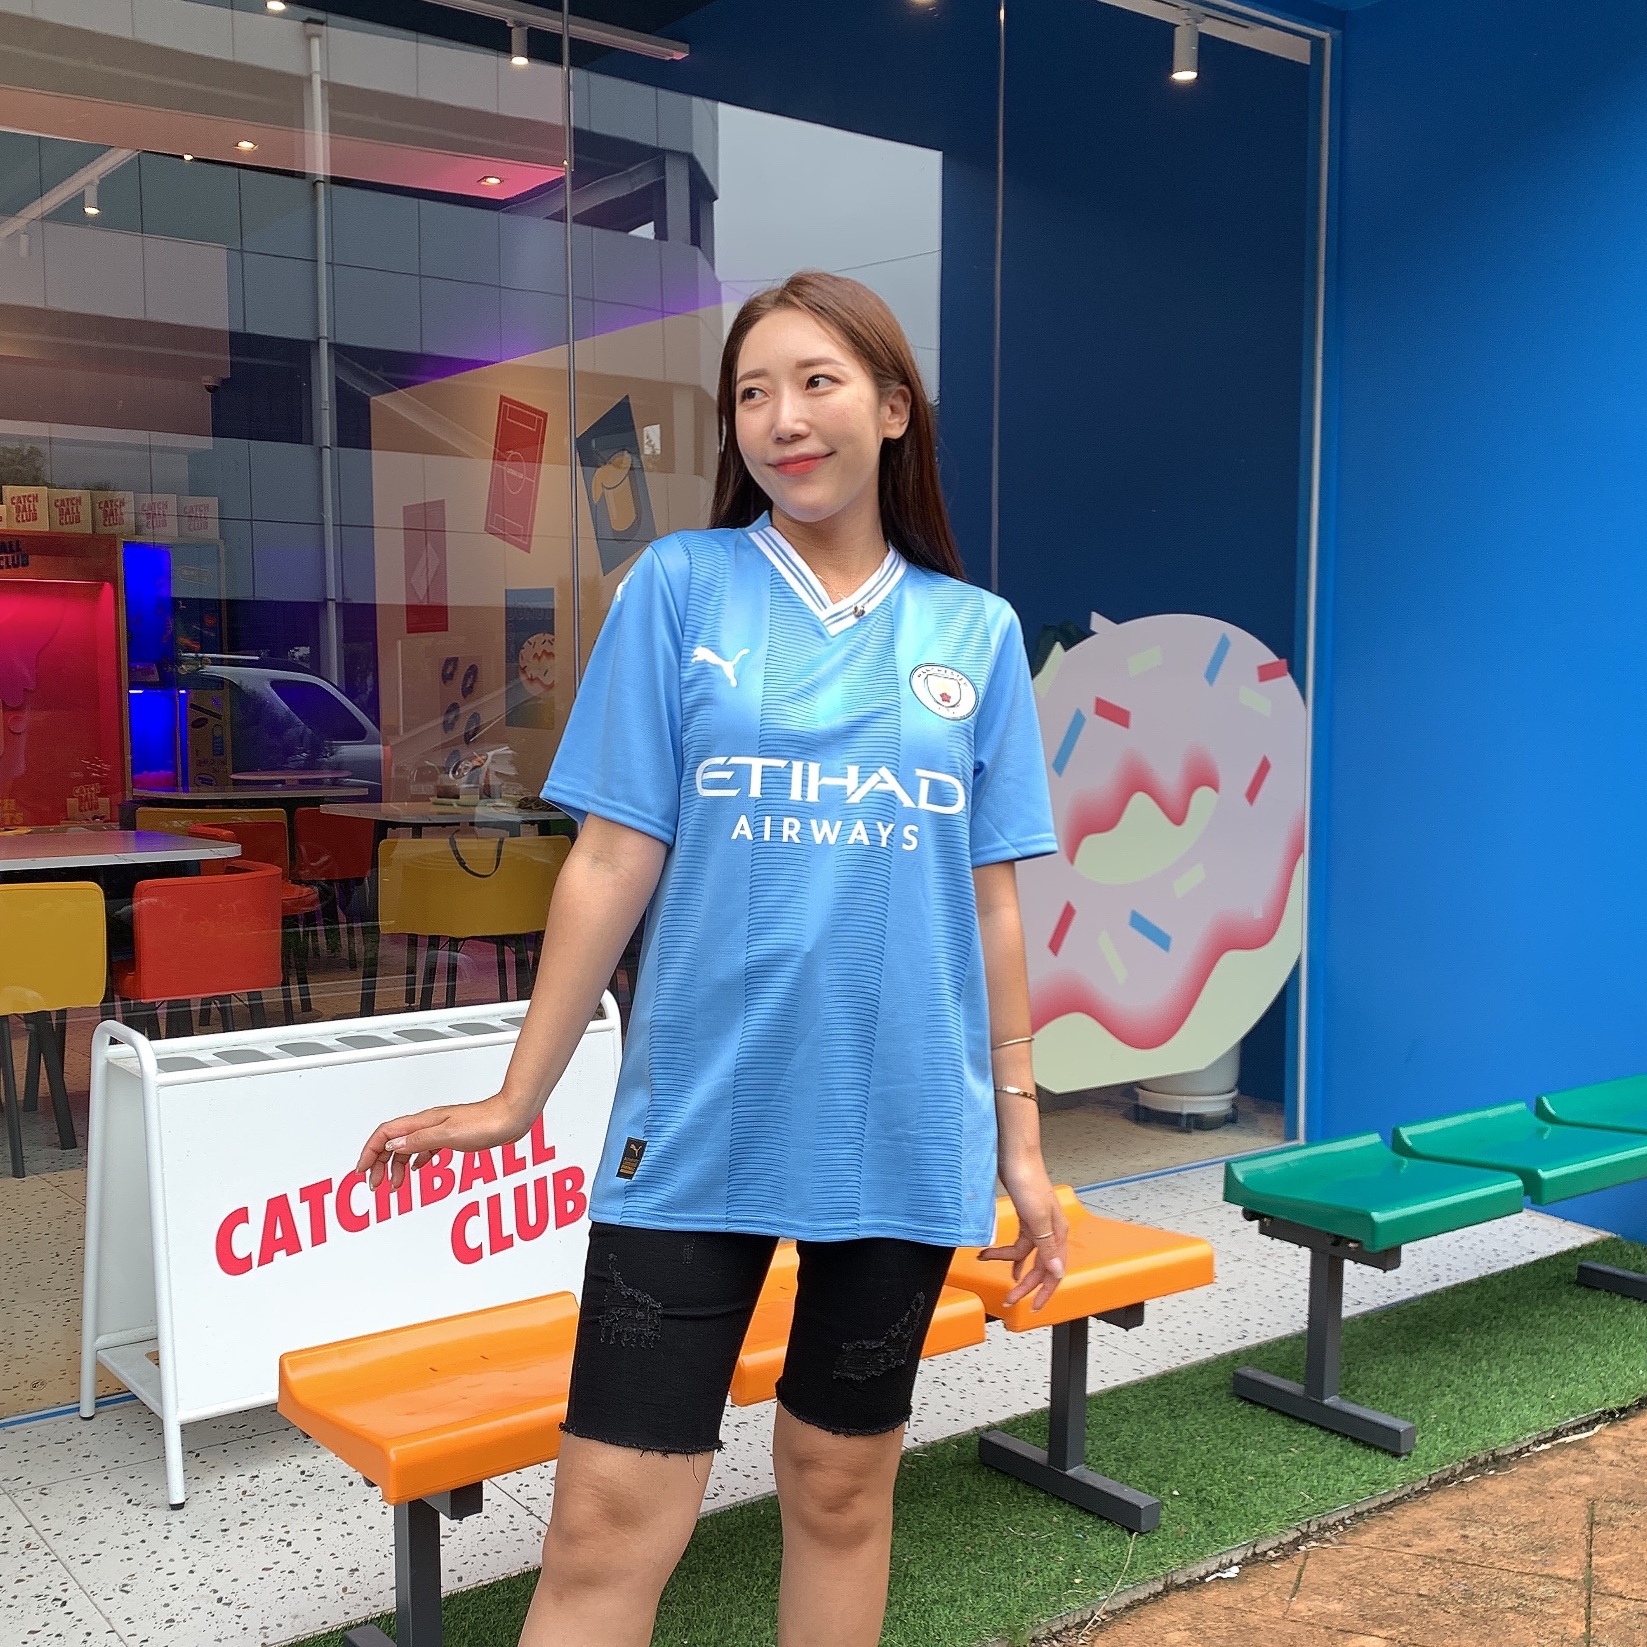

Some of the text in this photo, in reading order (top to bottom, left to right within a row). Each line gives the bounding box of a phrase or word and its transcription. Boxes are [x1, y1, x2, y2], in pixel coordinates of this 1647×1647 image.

[10, 493, 39, 506] CATCH
[54, 496, 82, 508] CATCH
[15, 503, 37, 514] BALL
[58, 506, 80, 517] BALL
[15, 512, 38, 523] CLUB
[59, 514, 81, 526] CLUB
[695, 756, 966, 815] ETIHAD
[731, 814, 919, 851] AIRWAYS
[215, 1110, 556, 1276] CATCHBALL
[451, 1165, 587, 1265] CLUB
